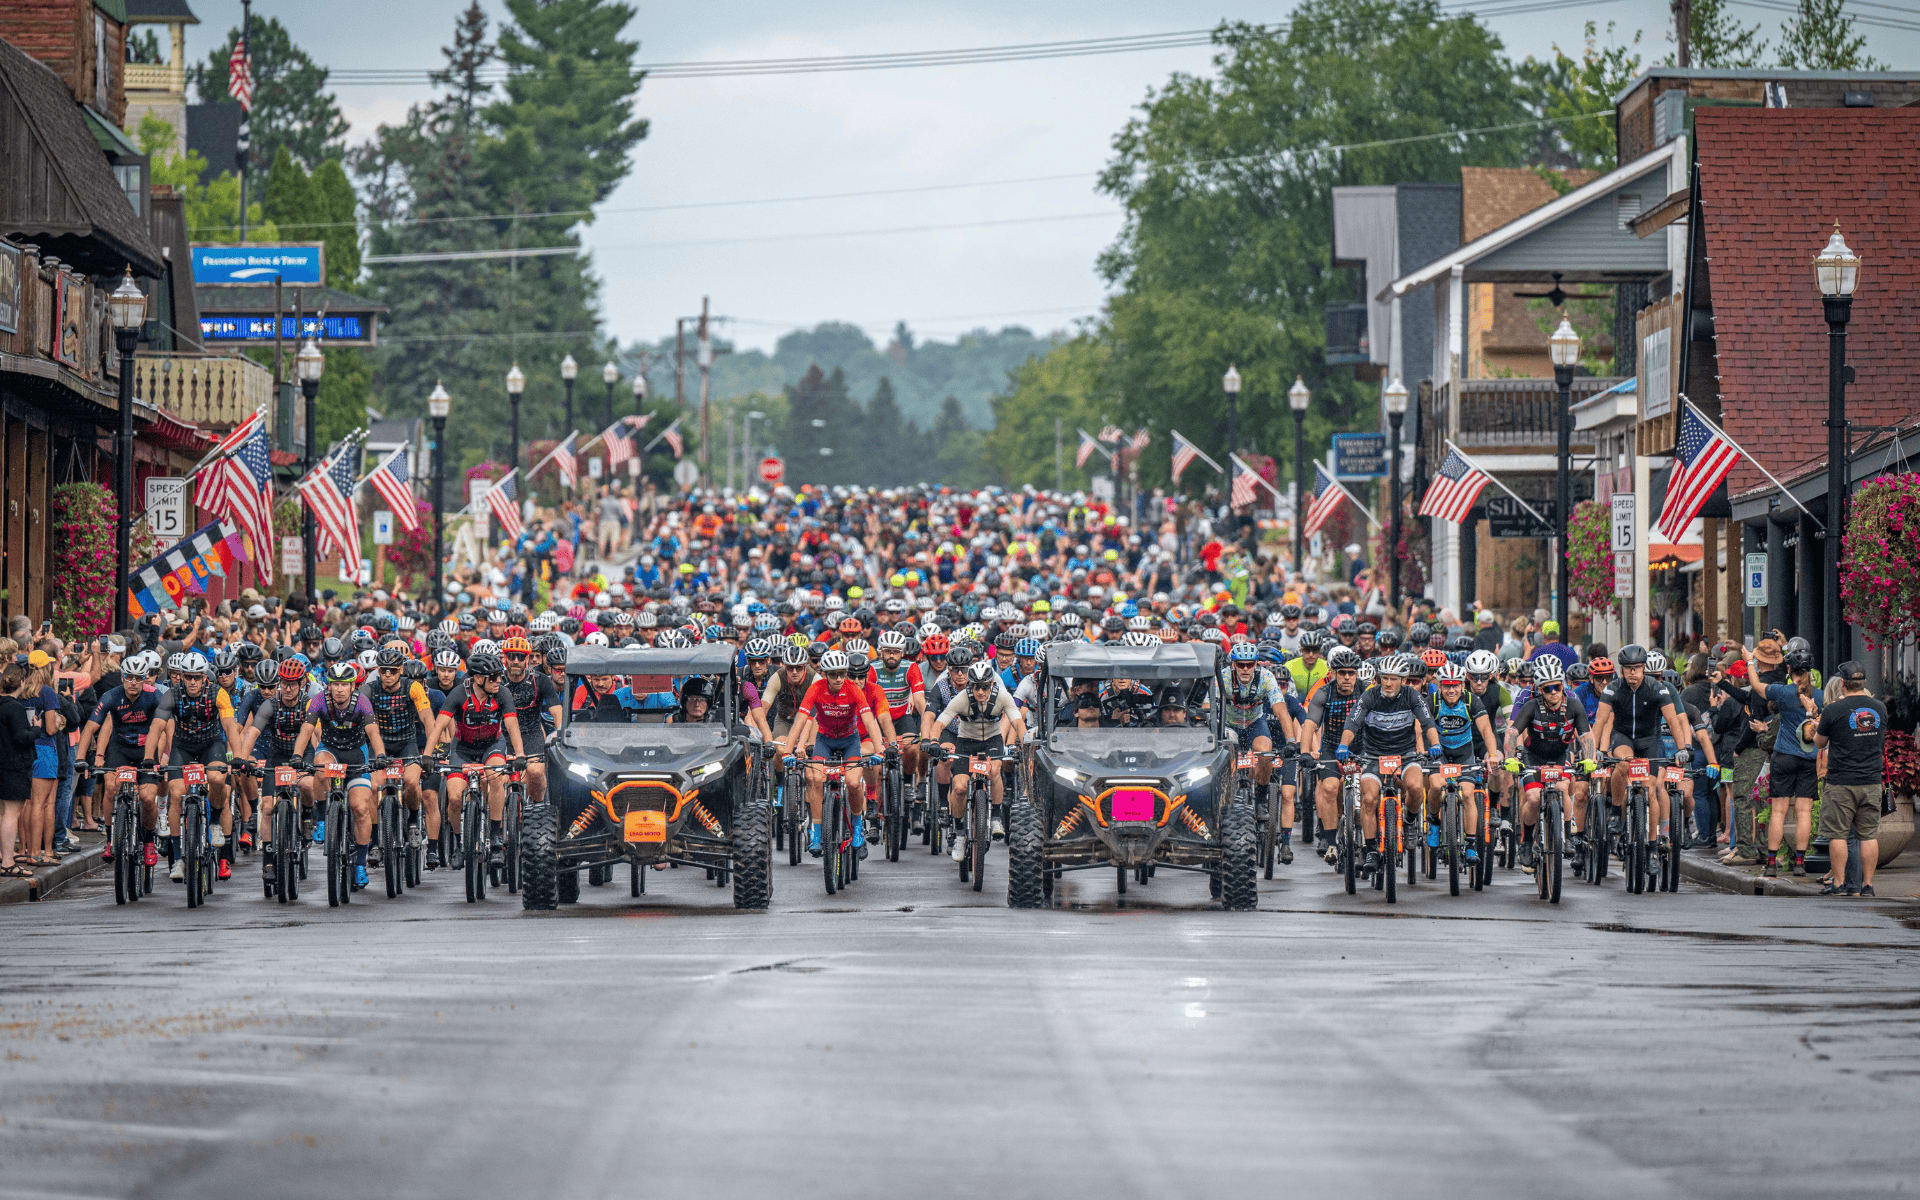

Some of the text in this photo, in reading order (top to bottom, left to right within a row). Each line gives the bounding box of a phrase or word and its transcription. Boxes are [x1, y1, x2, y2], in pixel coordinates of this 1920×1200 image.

[149, 484, 183, 494] SPEED
[152, 496, 179, 506] LIMIT
[1613, 499, 1634, 509] SPEED
[154, 509, 178, 531] 15
[1615, 512, 1631, 521] LIMIT
[1617, 525, 1631, 547] 15
[161, 546, 221, 596] OPEN
[1630, 766, 1647, 775] 1126
[187, 773, 201, 781] 274
[279, 773, 292, 782] 417
